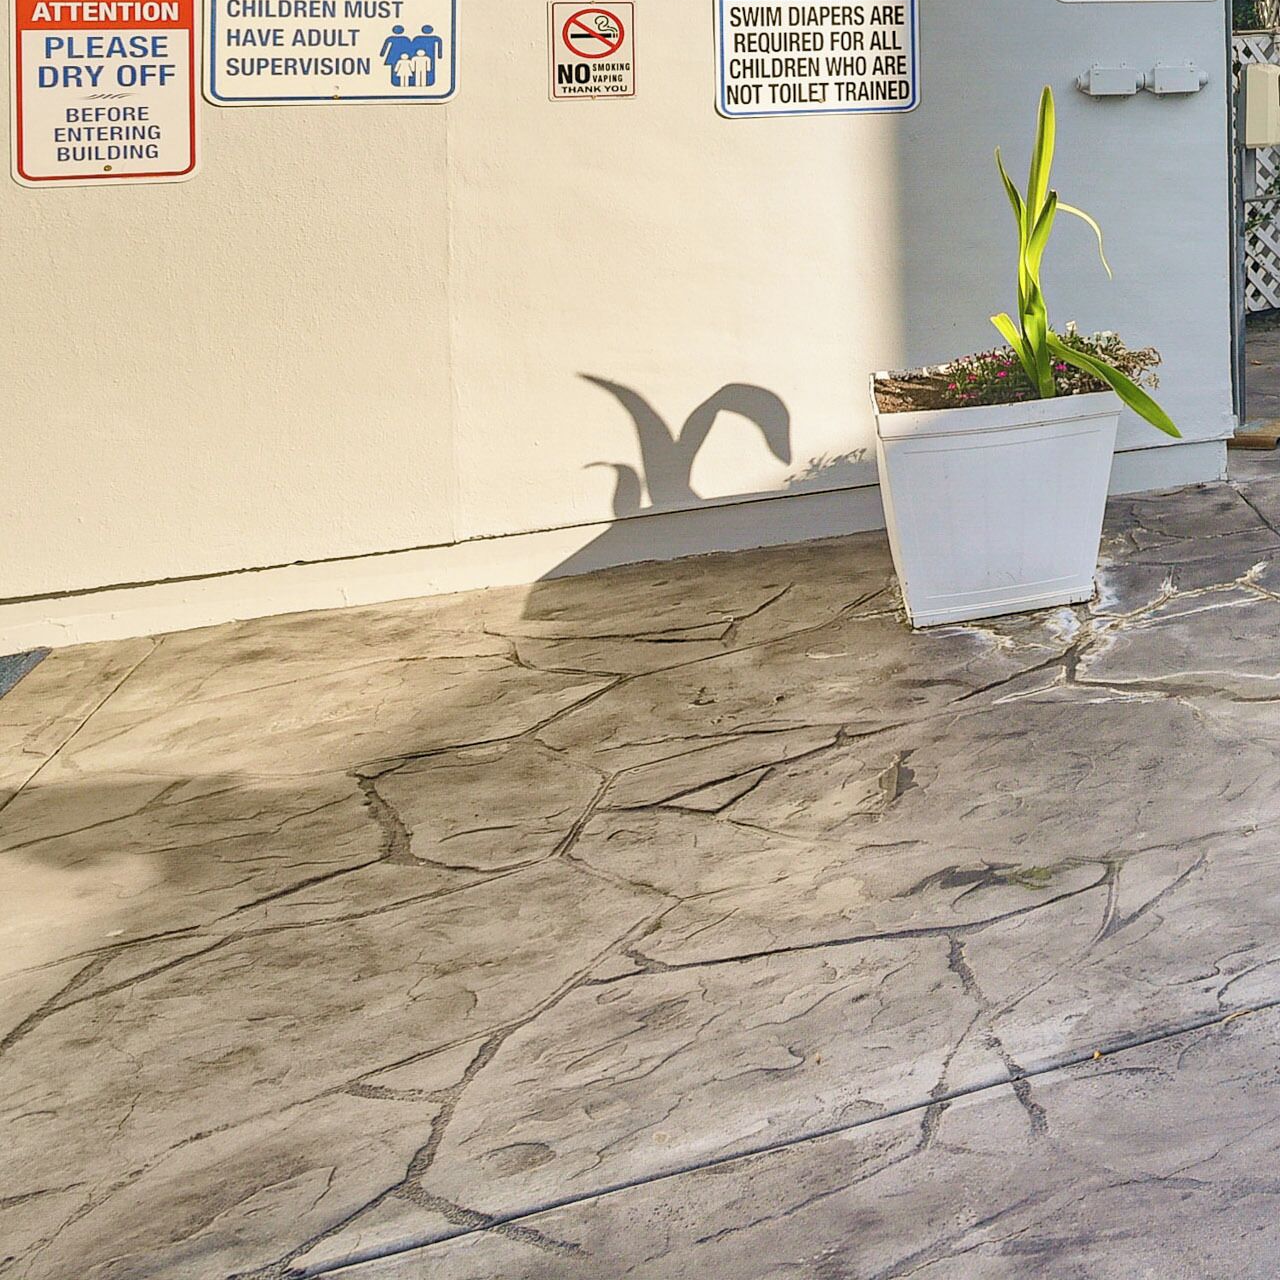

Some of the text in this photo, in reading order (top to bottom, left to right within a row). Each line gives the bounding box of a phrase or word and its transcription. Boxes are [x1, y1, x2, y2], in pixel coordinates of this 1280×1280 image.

[31, 1, 179, 22] ATTENTION
[226, 0, 404, 19] CHILDREN MUST
[730, 5, 905, 28] SWIM DIAPERS ARE
[45, 35, 169, 59] PLEASE
[226, 28, 361, 47] HAVE ADULT
[734, 30, 902, 54] REQUIRED FOR ALL
[38, 64, 176, 88] DRY OFF
[226, 57, 371, 76] SUPERVISION
[557, 63, 591, 85] NO
[592, 62, 630, 72] SMOKING
[729, 55, 907, 79] CHILDREN WHO ARE
[592, 74, 623, 83] VAPING
[726, 80, 910, 105] NOT TOILET TRAINED
[66, 106, 149, 123] BEFORE
[54, 125, 161, 143] ENTERING
[57, 144, 159, 162] BUILDING
